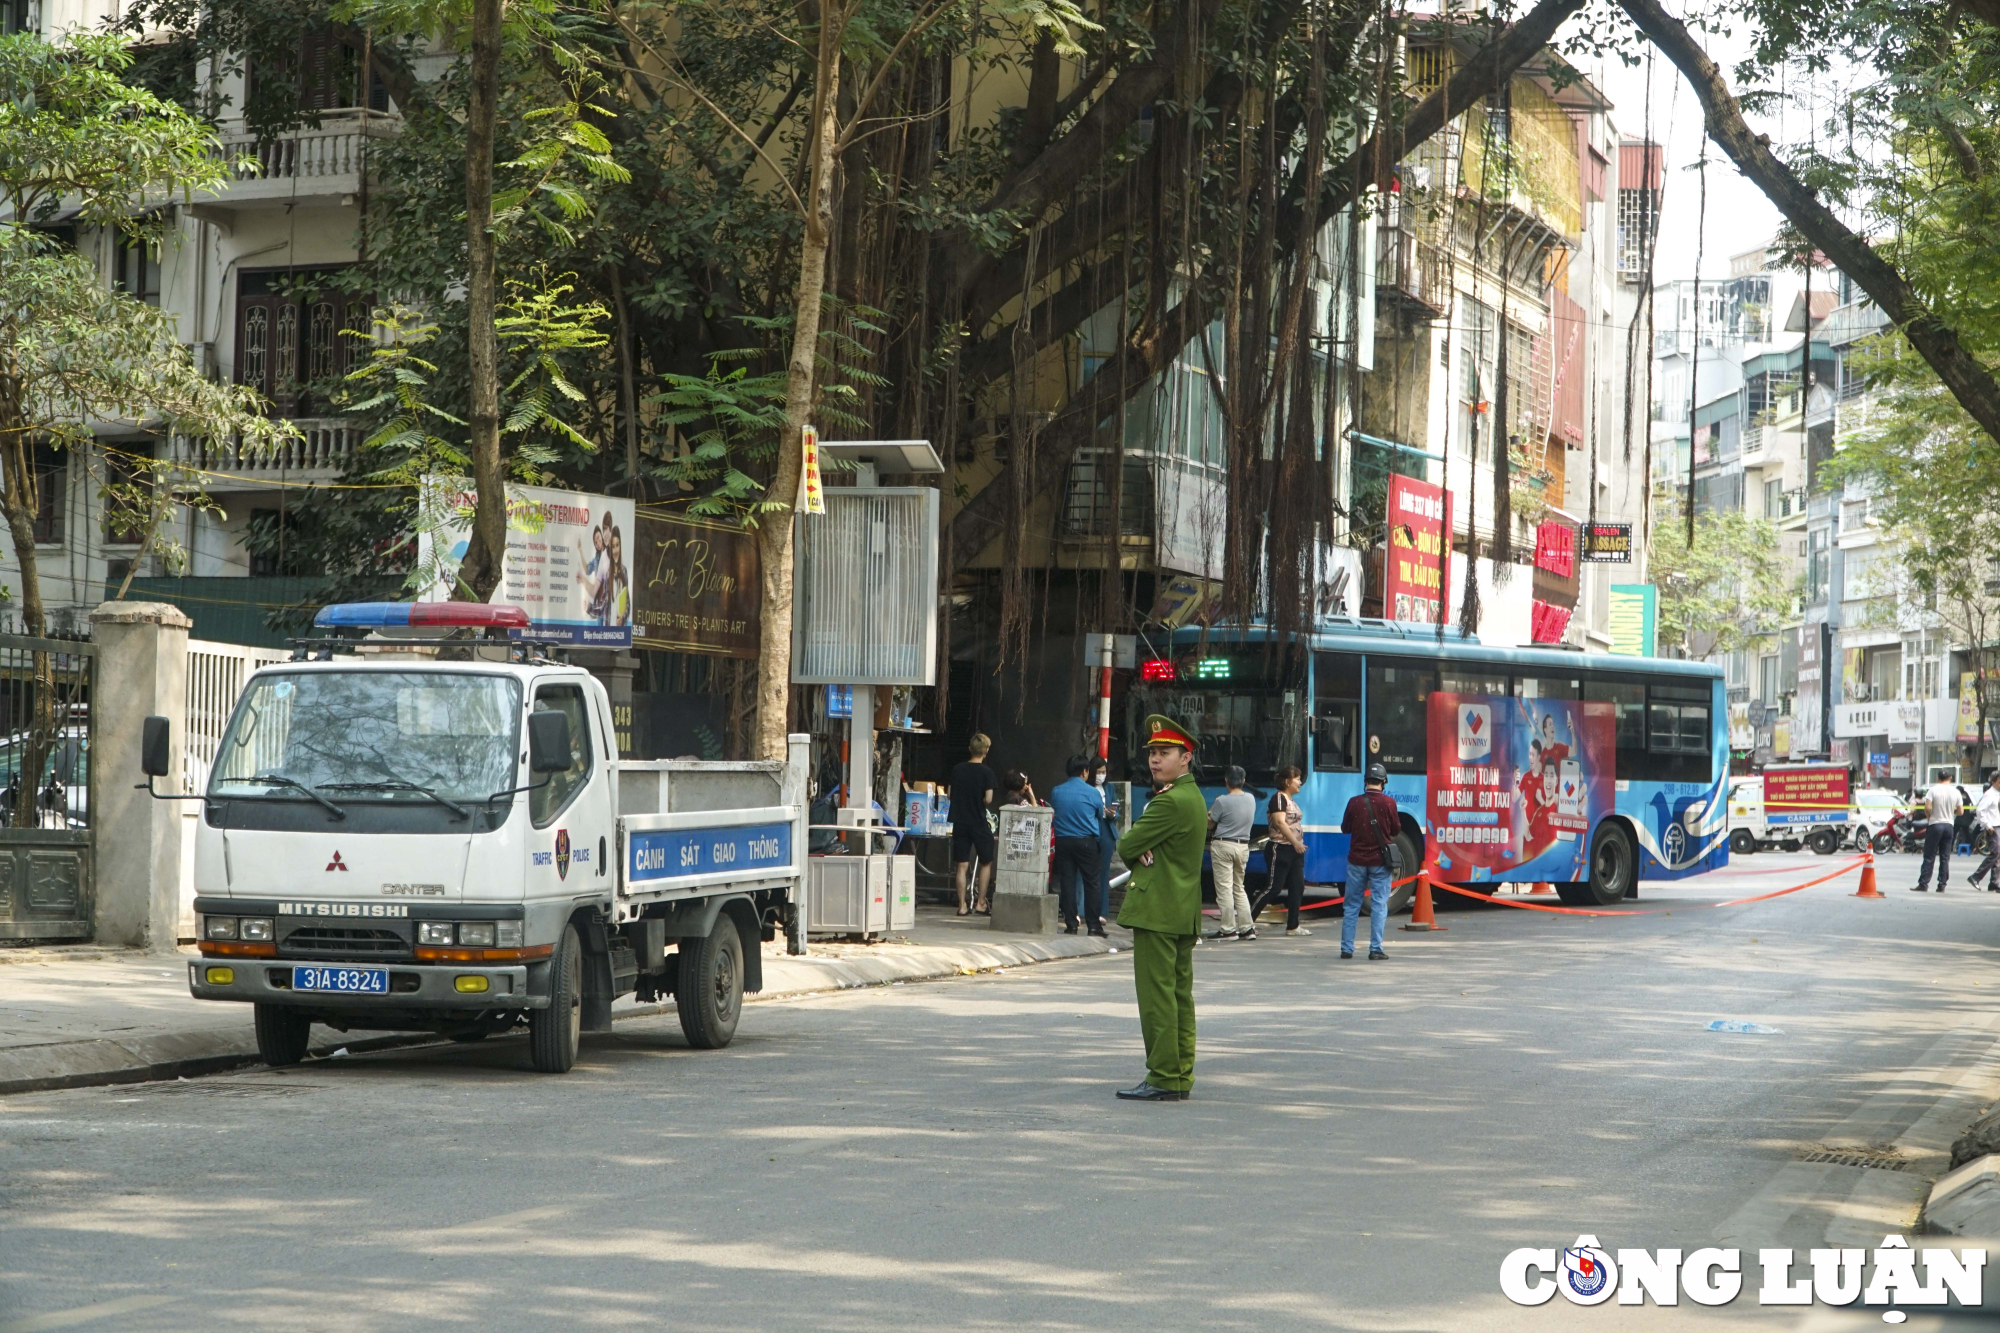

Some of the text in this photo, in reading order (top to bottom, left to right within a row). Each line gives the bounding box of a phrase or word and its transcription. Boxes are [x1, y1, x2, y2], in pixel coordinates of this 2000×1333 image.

[648, 539, 678, 588] In
[685, 539, 737, 600] Bloom
[614, 705, 632, 727] 343
[1449, 765, 1500, 786] THANH TOÁN
[1437, 789, 1455, 808] MUA
[1494, 792, 1510, 809] TAXI
[532, 848, 590, 866] TRAFFIC POLICE
[636, 834, 779, 871] CẢNH SÁT GIAO THÔNG
[380, 883, 445, 896] CANTER
[278, 902, 409, 918] MITSUBISHI
[303, 968, 382, 991] 31A-8324
